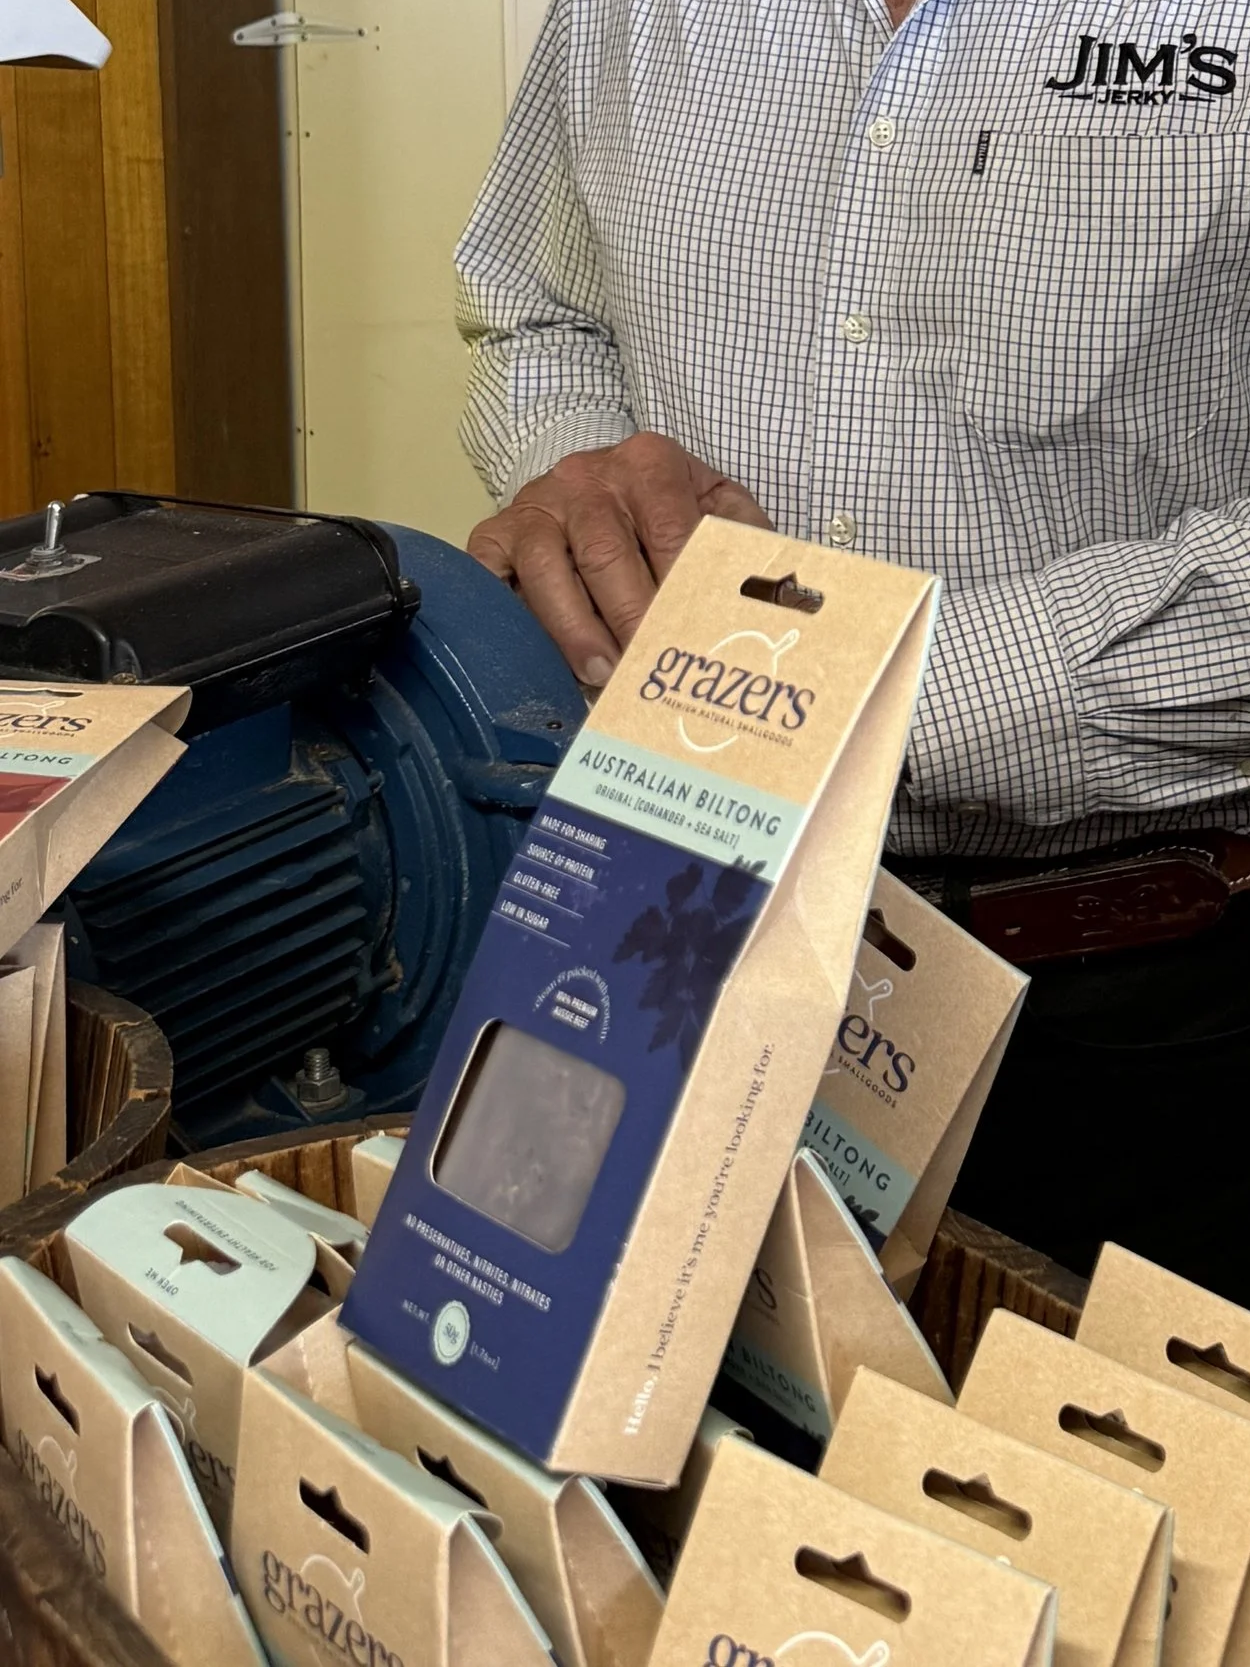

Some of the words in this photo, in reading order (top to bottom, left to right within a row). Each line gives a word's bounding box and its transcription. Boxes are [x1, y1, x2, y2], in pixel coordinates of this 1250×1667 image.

[1044, 32, 1239, 96] JIM'S
[1097, 89, 1176, 106] JERKY
[640, 646, 816, 730] grazers
[661, 696, 698, 715] PREMIUM
[699, 708, 735, 728] NATURAL
[736, 719, 795, 748] SMALLGOODS
[579, 748, 693, 804] AUSTRALIAN
[695, 788, 782, 837] BILTONG
[595, 784, 633, 808] ORIGINAL
[693, 821, 713, 836] SEA
[541, 814, 562, 832] MADE
[560, 822, 577, 838] FOR
[575, 828, 608, 851] SHARING
[527, 842, 556, 863] SOURCE
[553, 854, 566, 866] OF
[564, 858, 596, 881] PROTEIN
[500, 899, 518, 916] LOW
[515, 906, 526, 919] IN
[524, 909, 550, 931] SUGAR
[838, 1055, 898, 1109] SMALLGOODS
[804, 1109, 892, 1192] BILTONG
[650, 1288, 687, 1363] believe
[677, 1256, 698, 1287] it's
[691, 1222, 711, 1255] me
[705, 1156, 735, 1219] you're
[725, 1079, 765, 1155] looking
[145, 1267, 159, 1280] ME
[157, 1277, 179, 1296] OPEN
[405, 1212, 417, 1229] NO
[511, 1277, 552, 1311] NITRATES
[433, 1253, 446, 1268] OR
[446, 1258, 471, 1283] OTHER
